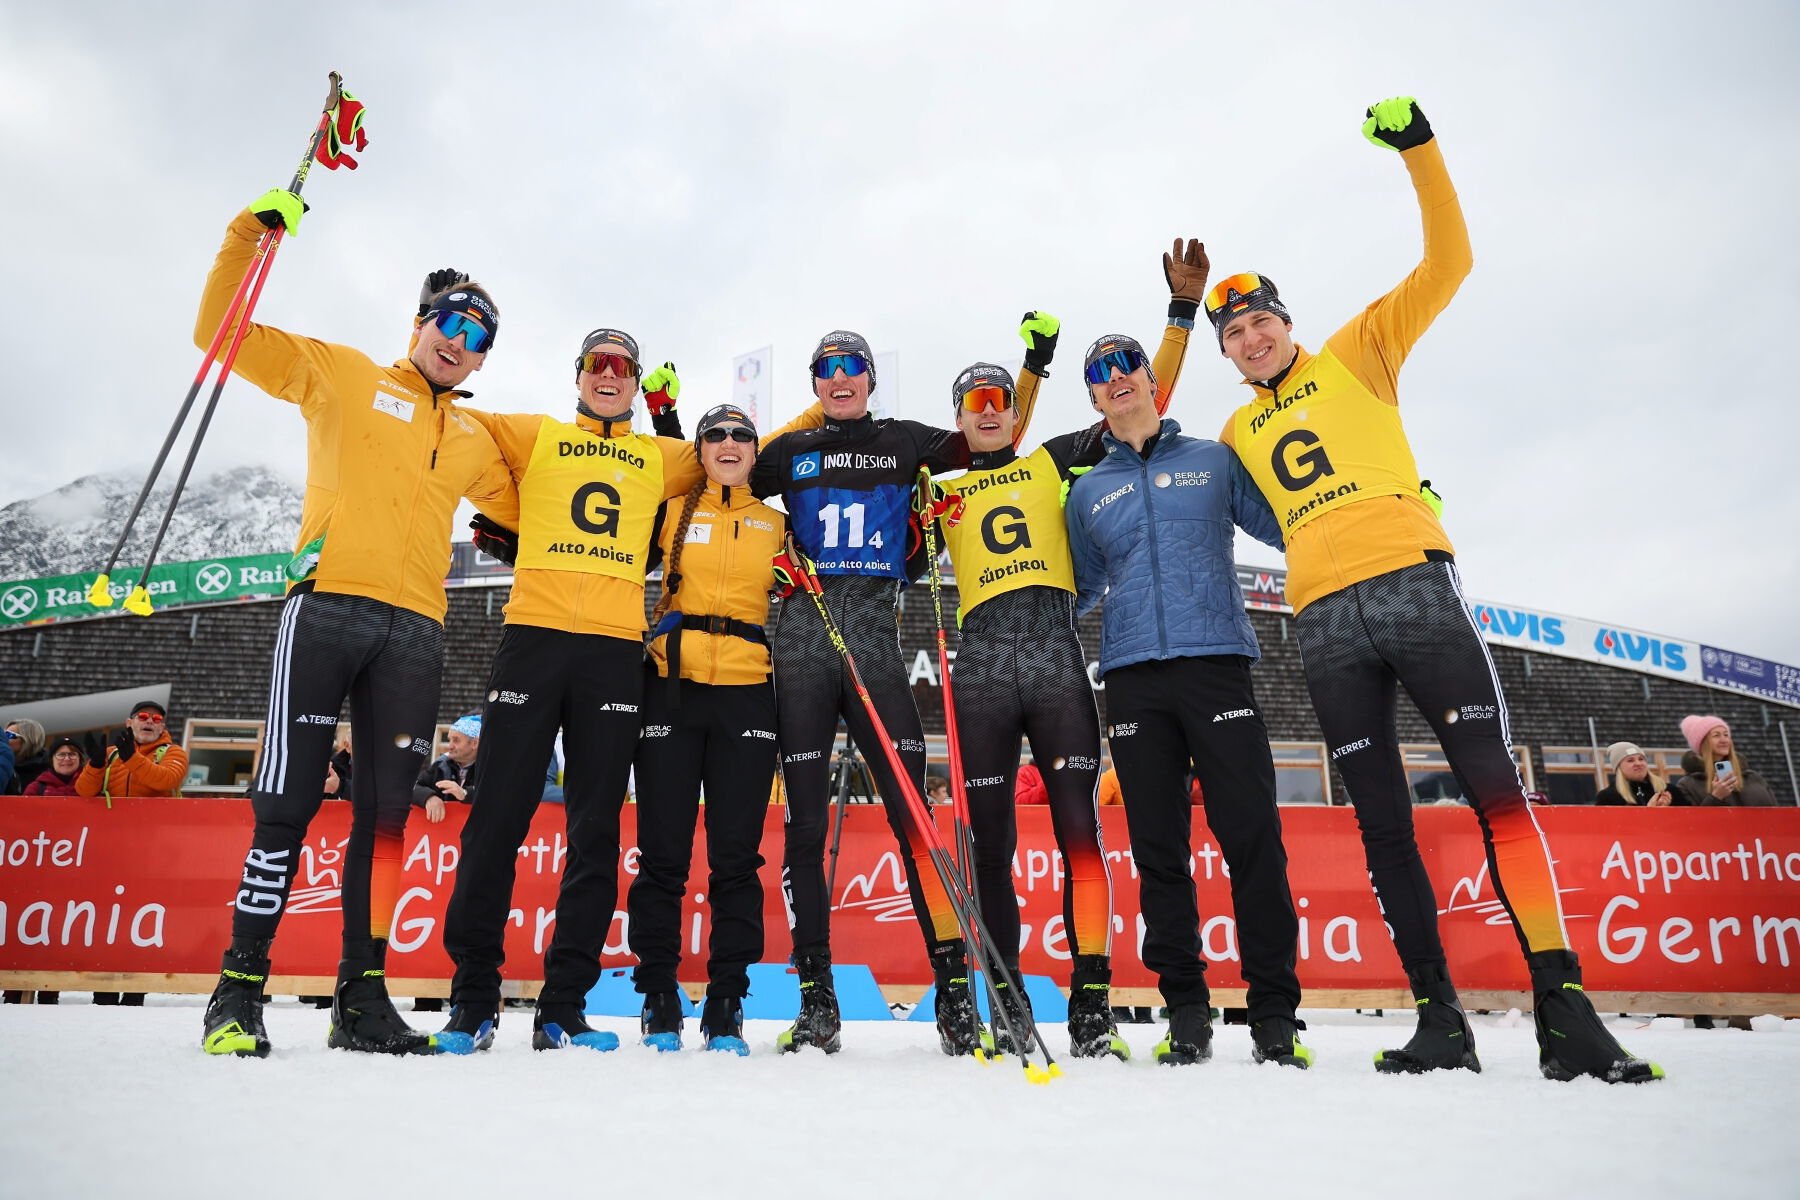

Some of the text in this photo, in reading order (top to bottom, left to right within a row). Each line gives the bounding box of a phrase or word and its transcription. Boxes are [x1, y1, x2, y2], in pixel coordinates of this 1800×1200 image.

[558, 441, 645, 469] Dobbiaco
[824, 453, 897, 469] INOX DESIGN
[1271, 429, 1336, 492] G
[1174, 471, 1211, 480] BERLAC
[956, 468, 1032, 499] Toblach
[1175, 479, 1208, 487] GROUP
[1099, 482, 1135, 507] TERREX
[570, 481, 621, 538] G
[818, 502, 884, 549] 11 4
[980, 505, 1032, 555] G
[1474, 604, 1566, 647] AVIS
[1594, 627, 1688, 672] AVIS
[499, 696, 526, 706] GROUP
[500, 690, 530, 702] BERLAC
[611, 703, 639, 714] TERREX
[1222, 708, 1255, 720] TERREX
[1461, 704, 1497, 714] BERLAC
[309, 714, 337, 725] TERREX
[1462, 711, 1494, 721] GROUP
[645, 724, 672, 732] BERLAC
[1115, 722, 1139, 731] BERLAC
[645, 730, 669, 738] GROUP
[752, 729, 777, 741] TERREX
[1115, 729, 1137, 738] GROUP
[901, 738, 925, 748] BERLAC
[901, 744, 924, 753] GROUP
[1335, 737, 1372, 758] TERREX
[793, 750, 822, 763] TERREX
[1068, 755, 1098, 767] BERLAC
[1067, 762, 1095, 771] GROUP
[970, 775, 1005, 788] TERREX
[235, 848, 290, 916] GER
[1597, 894, 1800, 968] Germ
[222, 969, 264, 983] FISCHER
